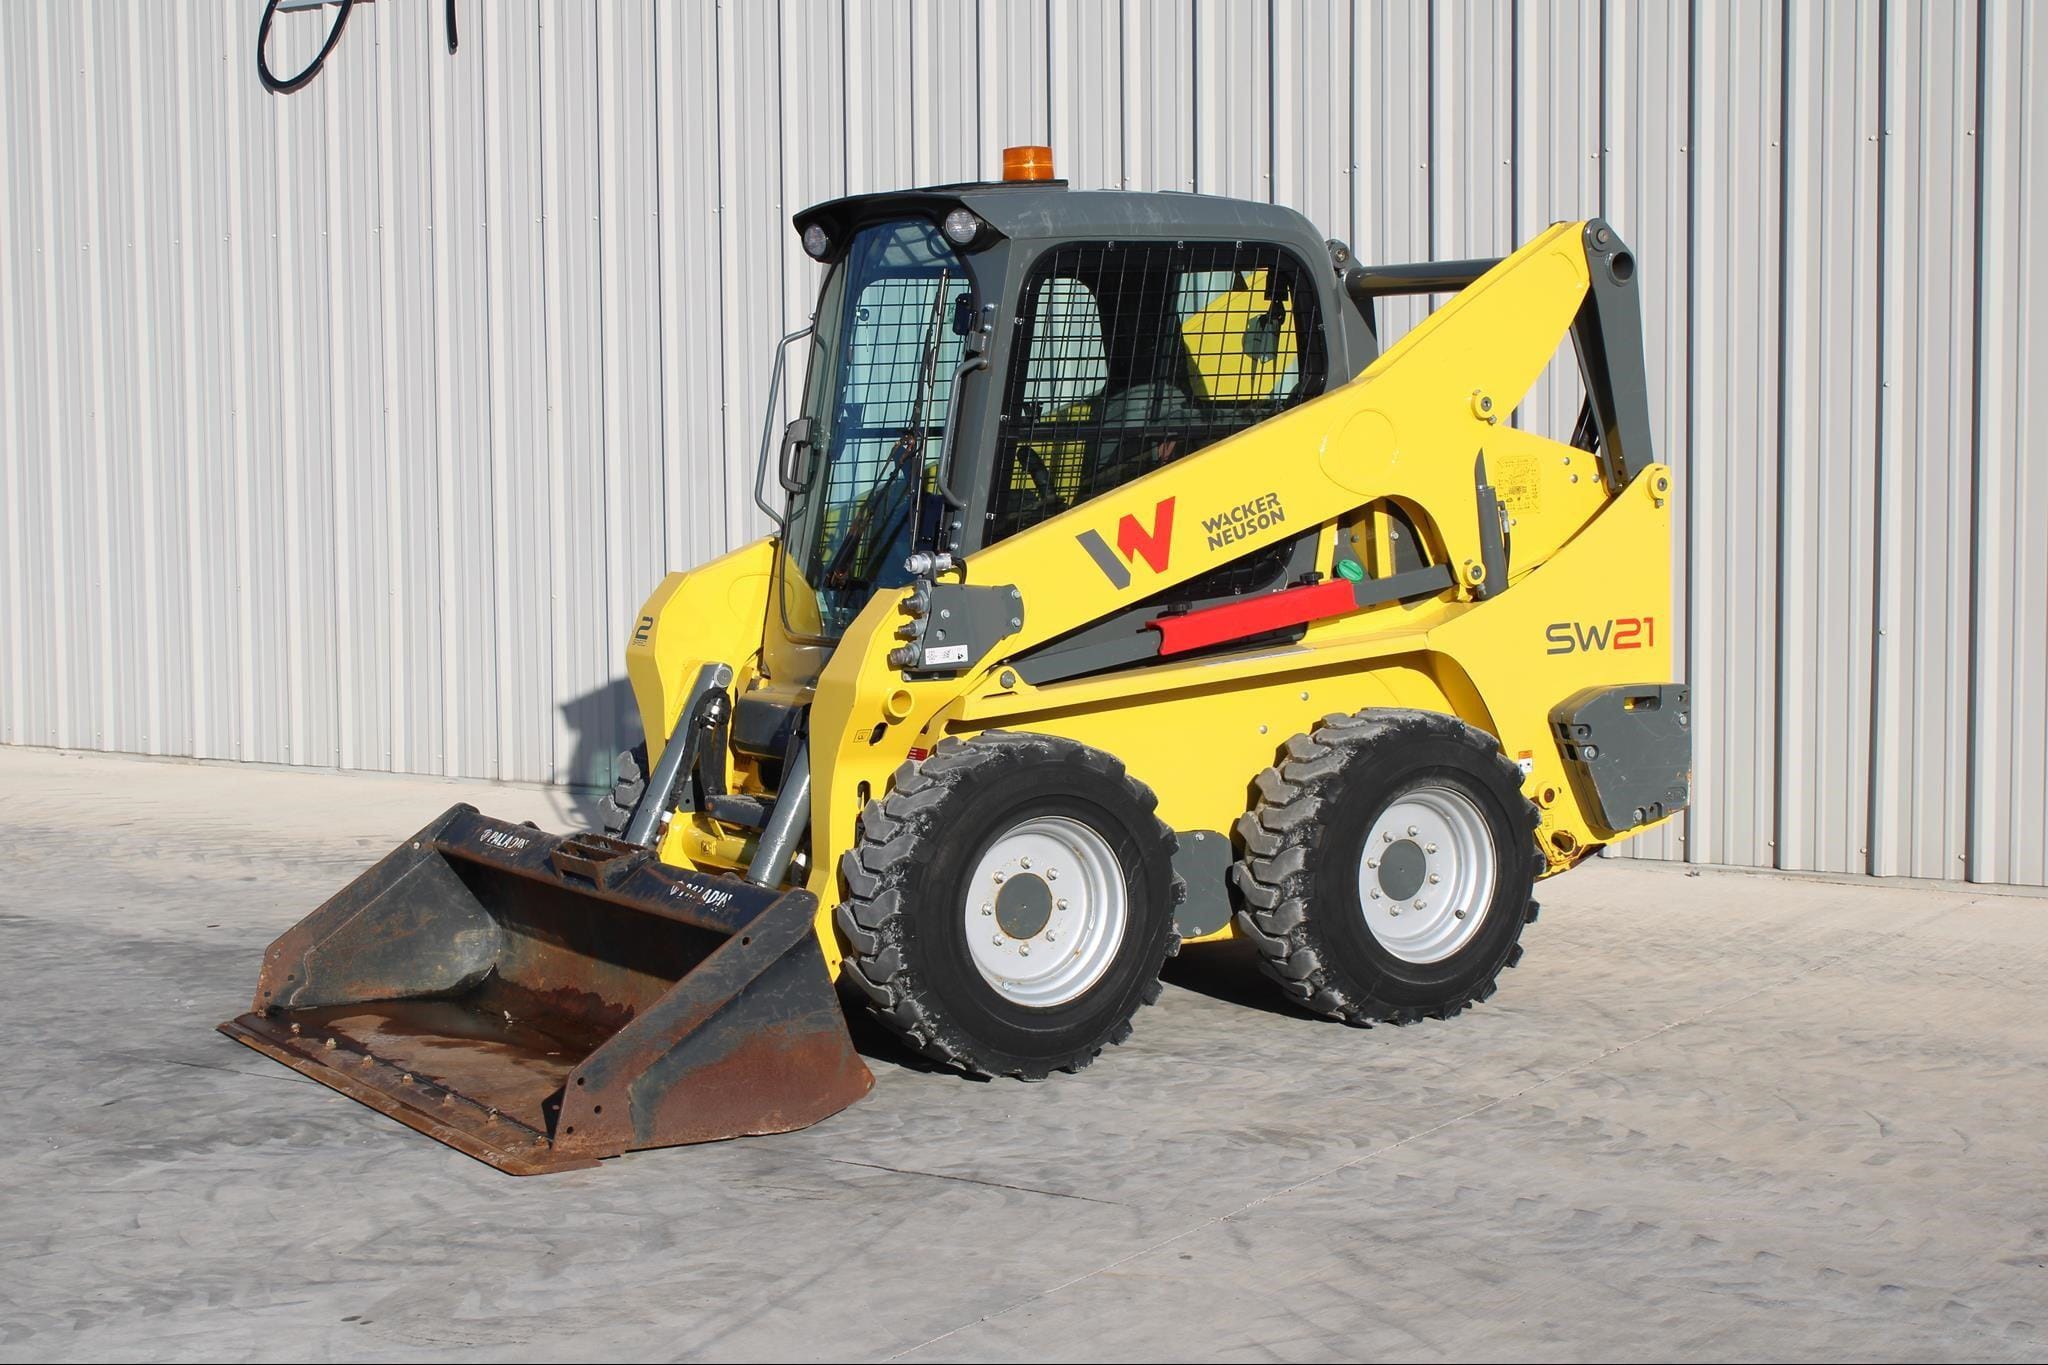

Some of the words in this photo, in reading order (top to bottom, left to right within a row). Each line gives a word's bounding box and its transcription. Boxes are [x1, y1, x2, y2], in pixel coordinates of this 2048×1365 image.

[1202, 492, 1281, 534] WACKER
[1207, 506, 1285, 552] NEUSON
[1546, 616, 1654, 655] SW21
